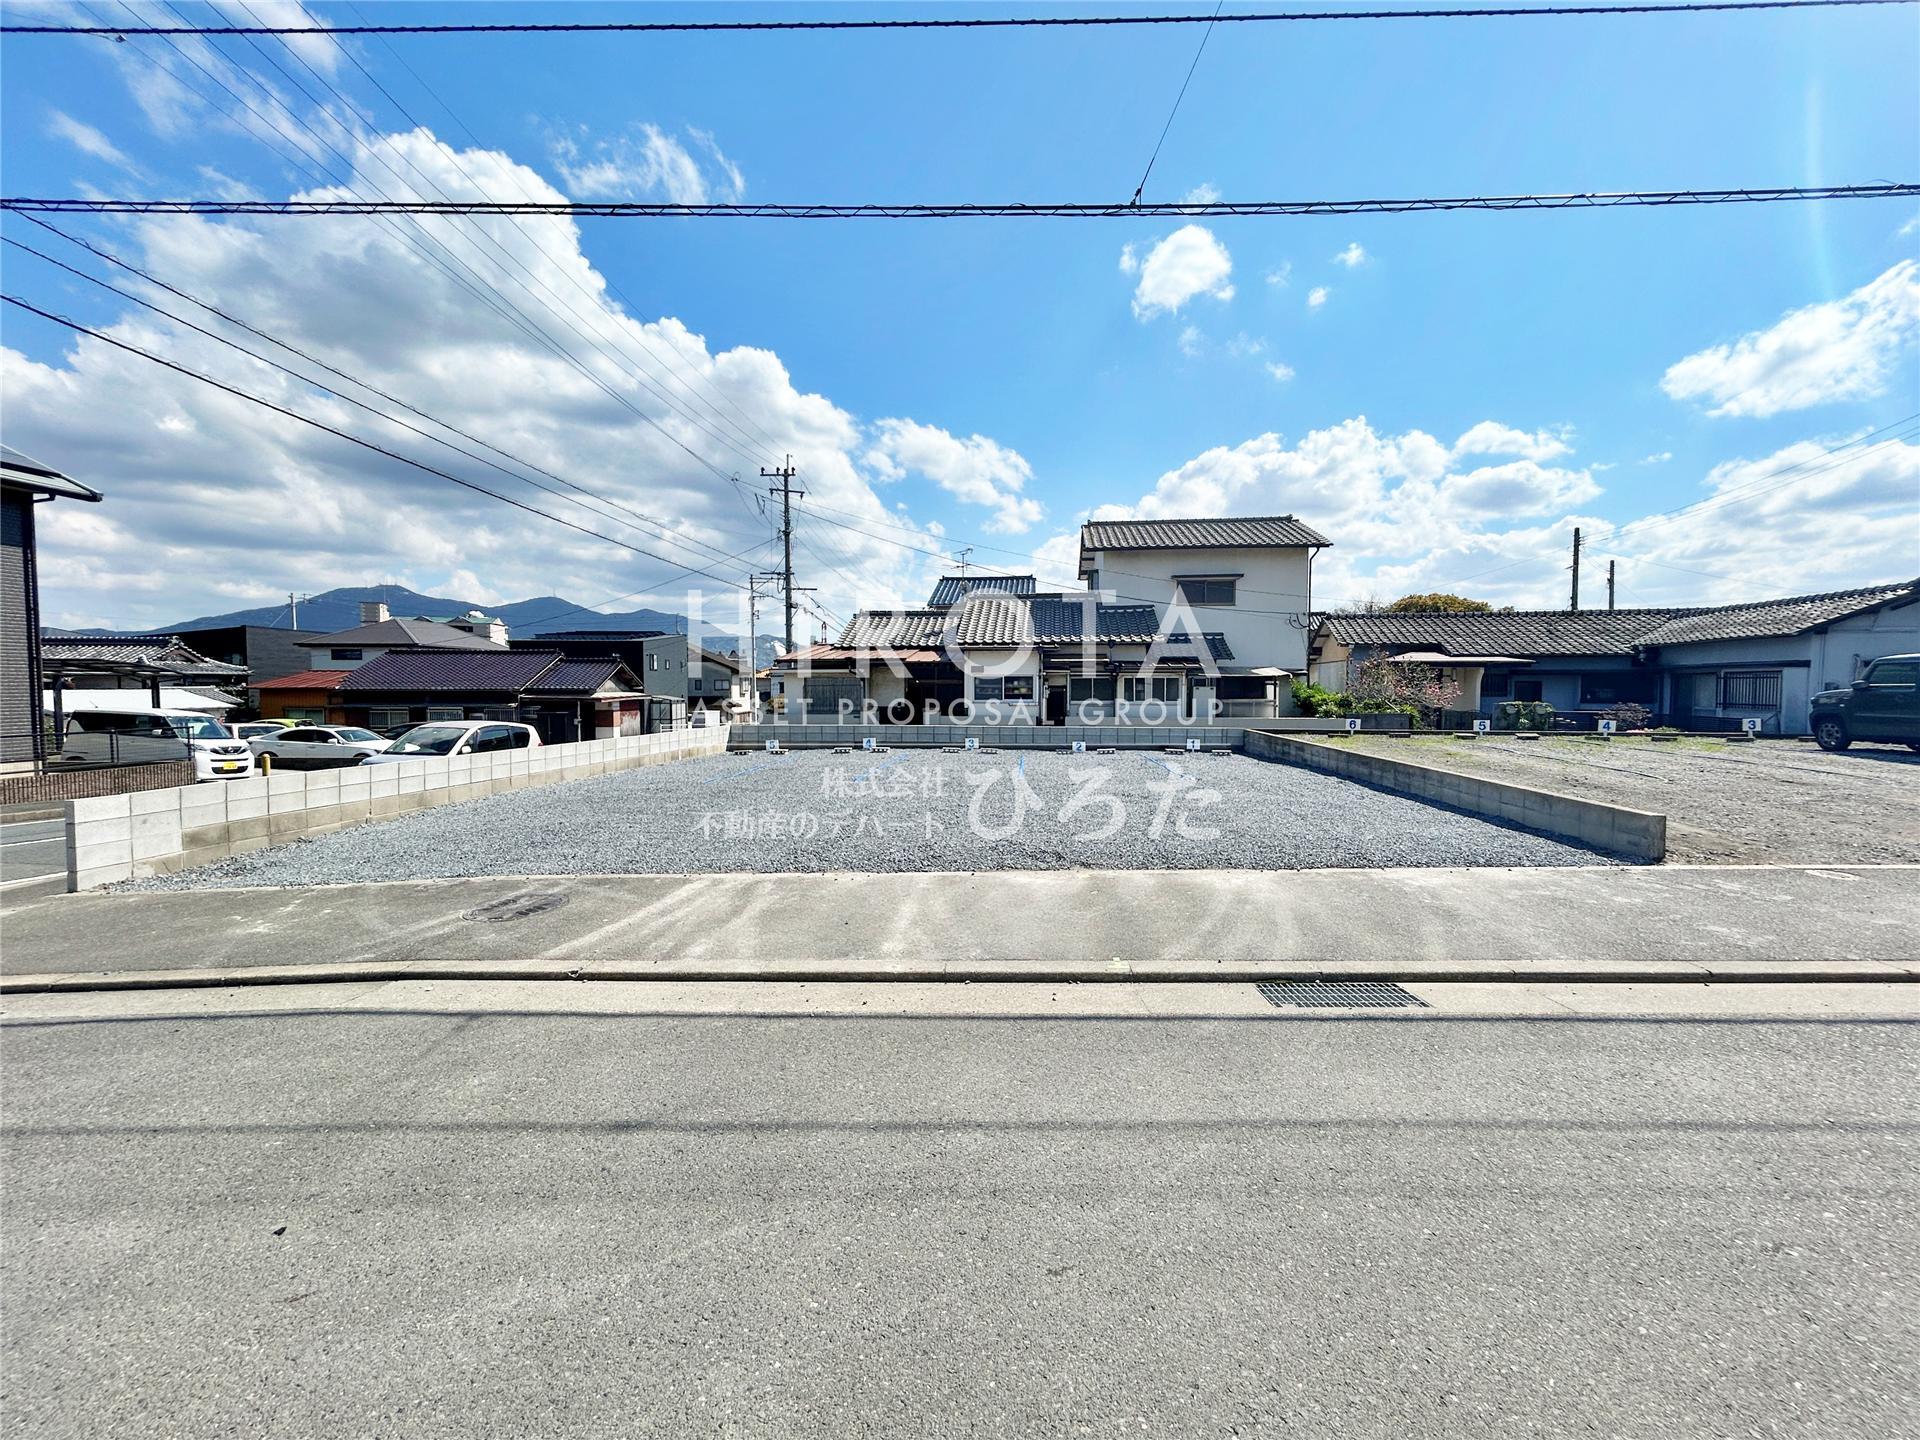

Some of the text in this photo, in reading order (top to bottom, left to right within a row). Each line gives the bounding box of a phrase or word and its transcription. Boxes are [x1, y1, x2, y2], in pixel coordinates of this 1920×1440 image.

[1349, 719, 1357, 729] 6
[1478, 720, 1487, 730] 5
[1602, 720, 1611, 731] 4
[1748, 719, 1757, 730] 3
[769, 740, 776, 749] 5
[865, 738, 872, 748] 4
[968, 738, 976, 748] 3
[1075, 742, 1082, 751] 2
